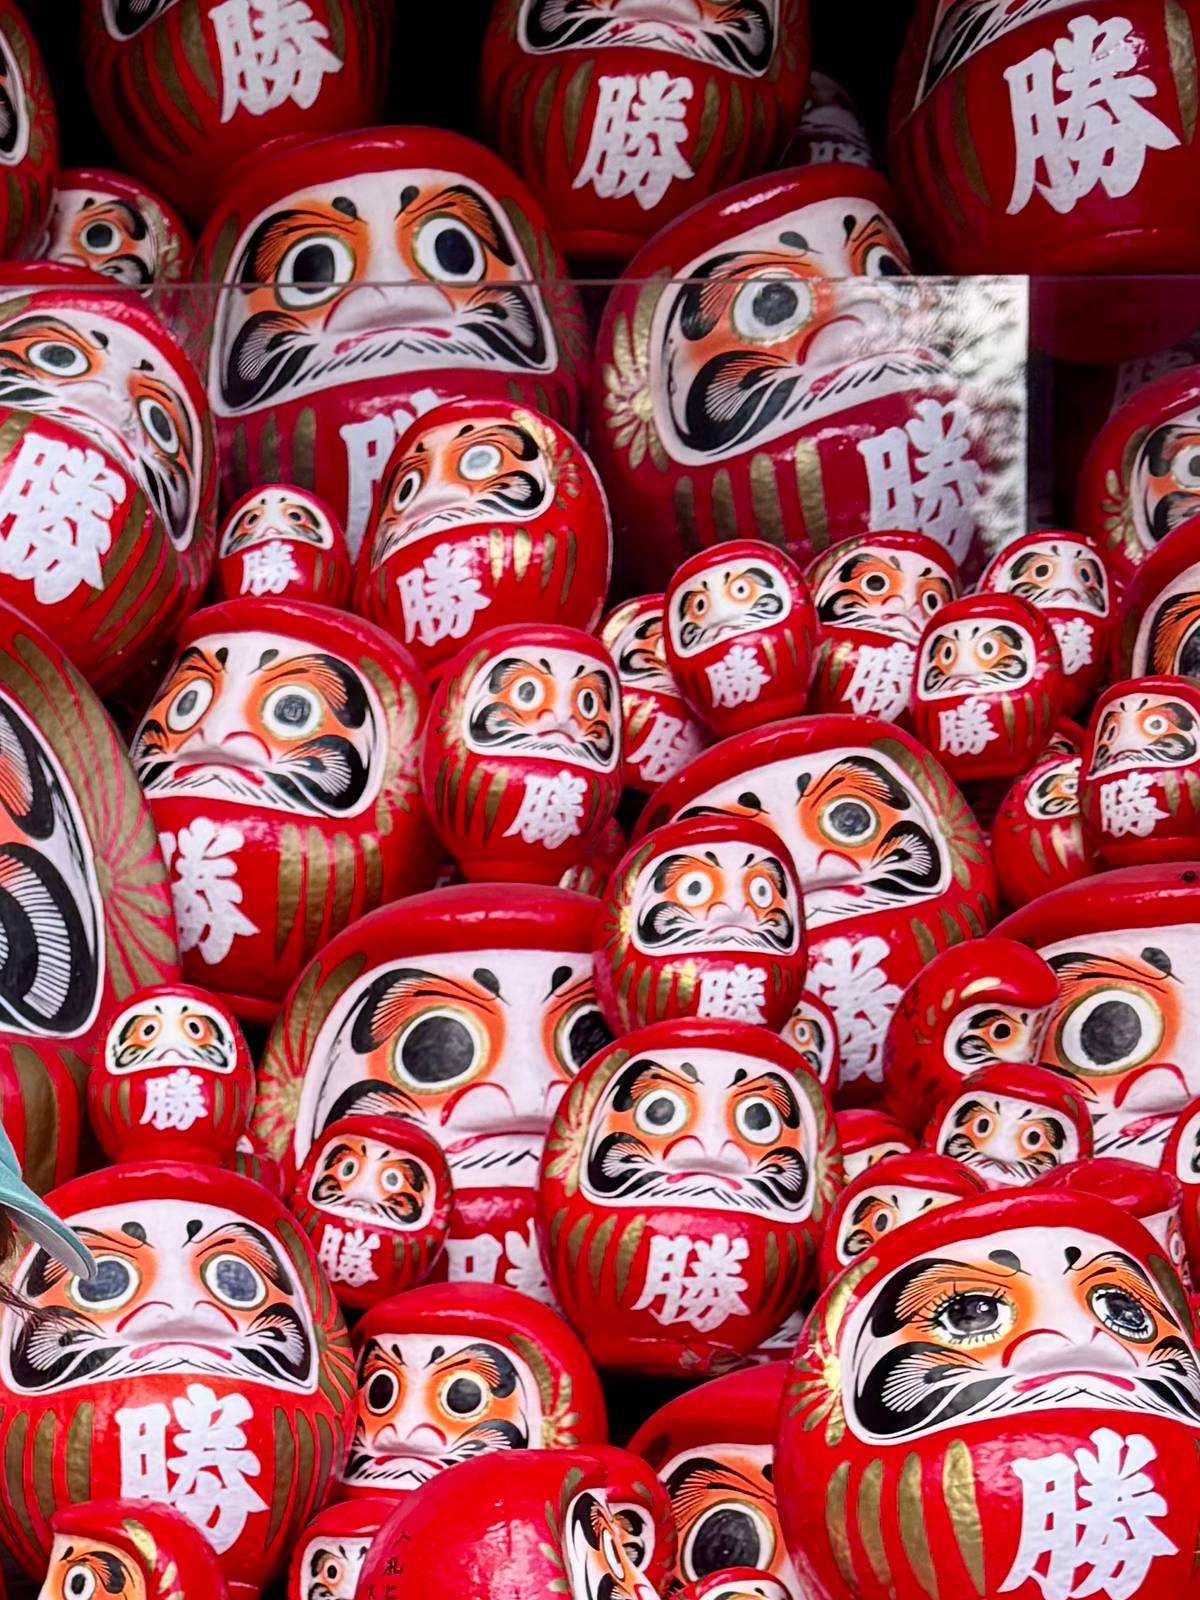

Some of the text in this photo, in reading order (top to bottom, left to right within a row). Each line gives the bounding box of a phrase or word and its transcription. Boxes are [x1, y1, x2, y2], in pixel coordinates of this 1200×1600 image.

[209, 0, 343, 123] 勝
[573, 71, 694, 210] 勝
[1003, 15, 1182, 215] 勝
[856, 398, 985, 567] 勝
[240, 541, 301, 596] 勝
[396, 543, 491, 647] 勝
[705, 646, 770, 708] 勝
[842, 642, 914, 722] 勝
[938, 699, 998, 756] 勝
[503, 771, 588, 849] 勝
[1100, 771, 1170, 837] 勝
[161, 817, 259, 964] 勝
[698, 966, 767, 1024] 勝
[140, 1068, 208, 1130] 勝
[320, 1225, 380, 1287] 勝
[635, 1235, 752, 1332] 勝
[116, 1385, 268, 1554] 勝
